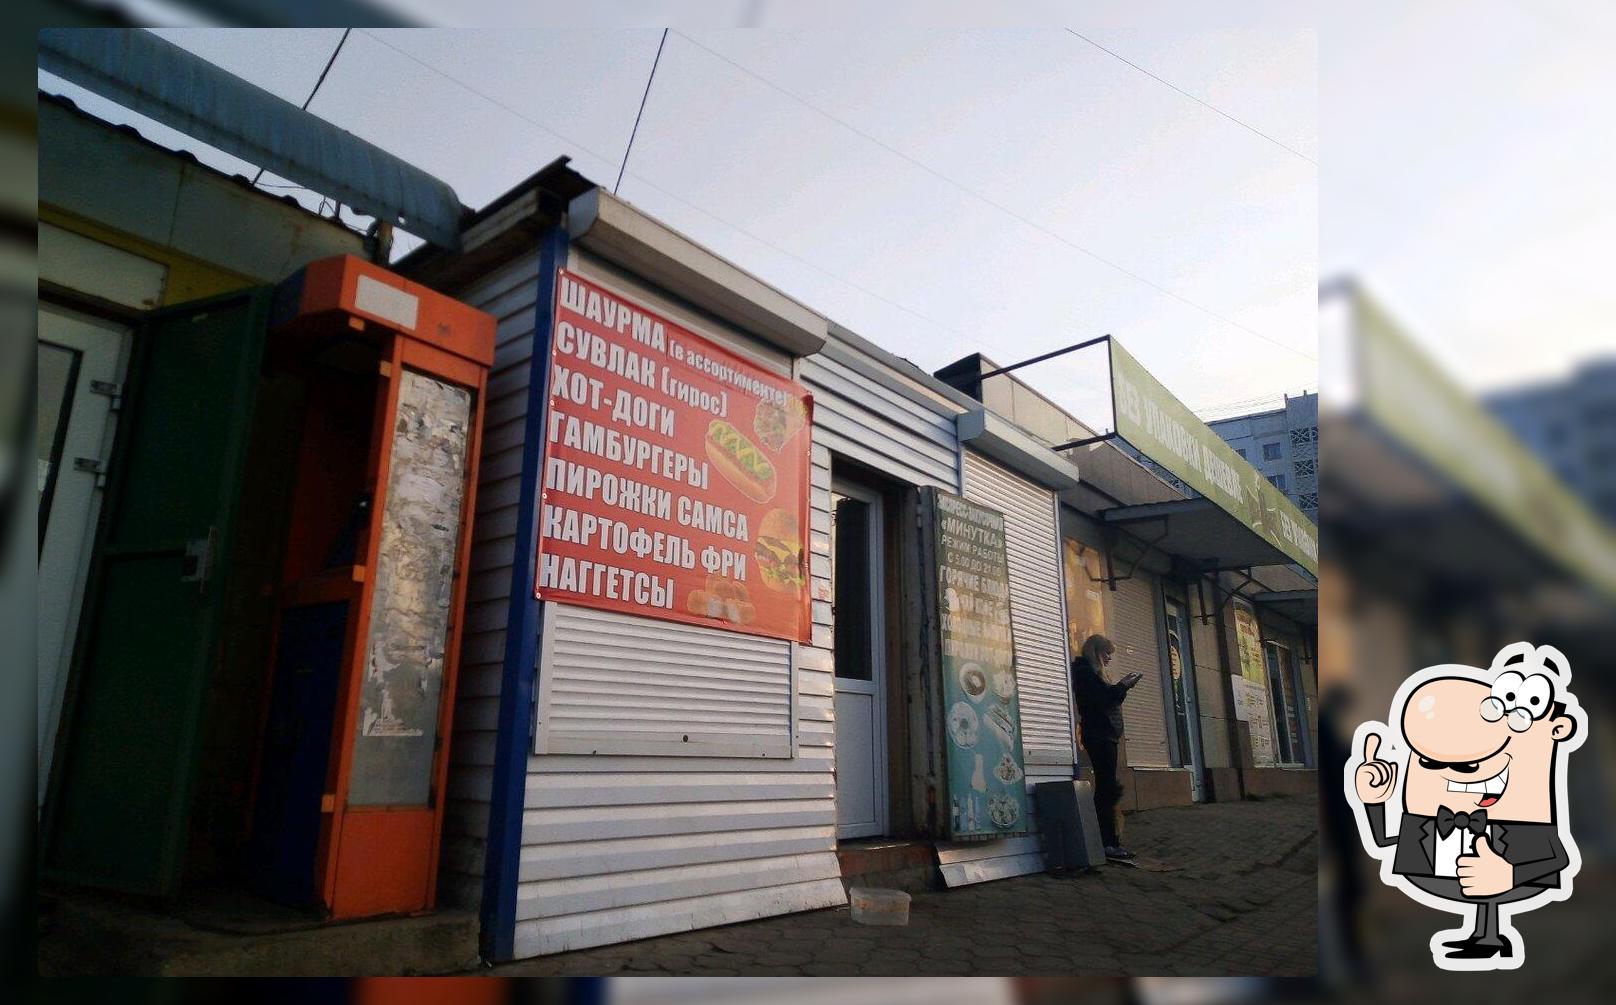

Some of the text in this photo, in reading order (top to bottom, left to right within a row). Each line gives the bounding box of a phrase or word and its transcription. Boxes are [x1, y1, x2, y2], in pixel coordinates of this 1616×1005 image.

[559, 276, 665, 353] ШАУРМА
[669, 340, 684, 361] (в
[551, 364, 675, 438] ХОТ-ДОГИ
[556, 321, 729, 418] СУВЛАК (гирос)
[550, 410, 708, 490] ГАМБУРГЕРЫ
[546, 456, 749, 542] ПИРОЖКИ САМСА
[539, 552, 675, 609] НАГГЕТСЫ
[542, 503, 747, 581] КАРТОФЕЛЬ ФРИ
